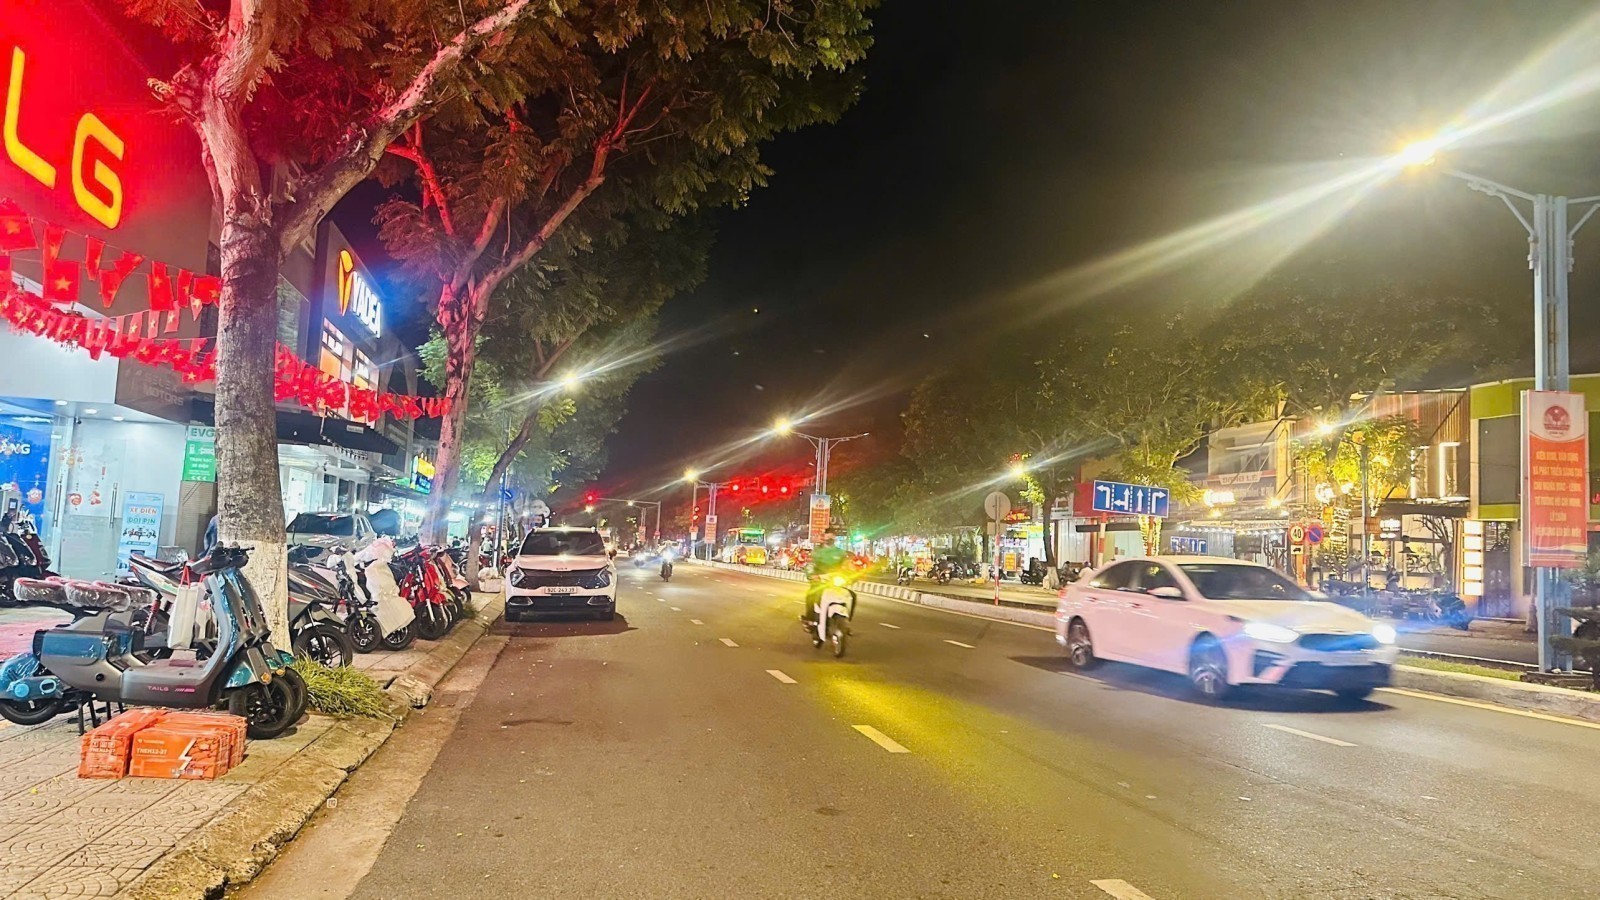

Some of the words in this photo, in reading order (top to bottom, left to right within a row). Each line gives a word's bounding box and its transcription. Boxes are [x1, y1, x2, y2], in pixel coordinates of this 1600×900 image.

[352, 271, 381, 339] YADEA
[144, 384, 184, 406] MOTORS
[1293, 528, 1302, 539] 40
